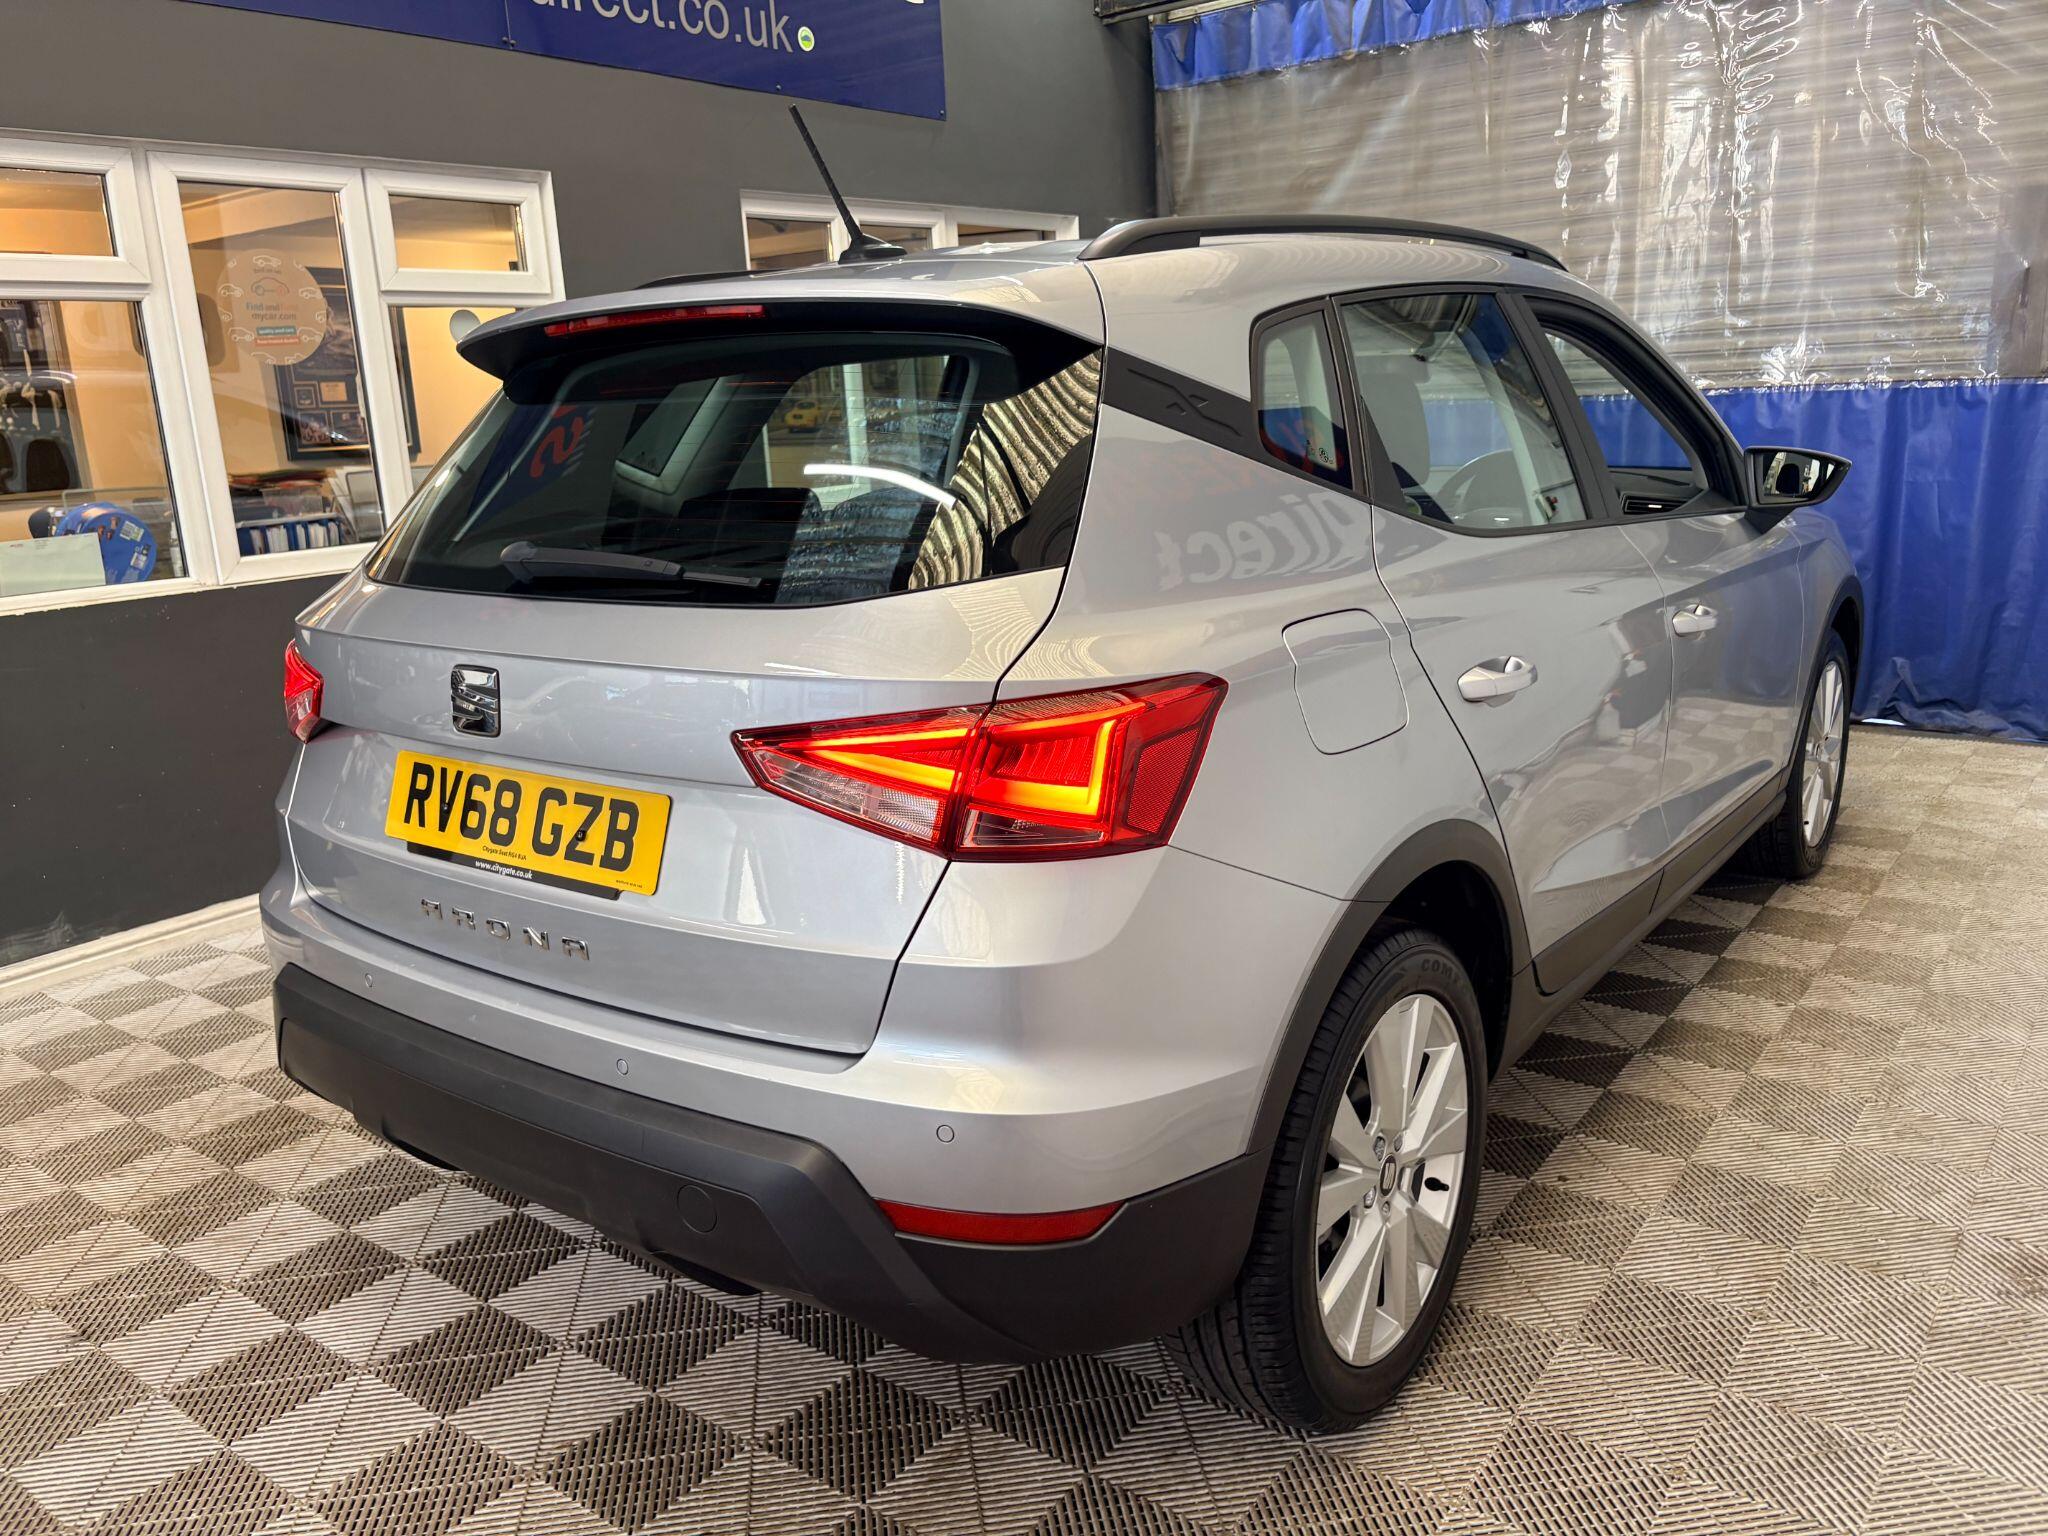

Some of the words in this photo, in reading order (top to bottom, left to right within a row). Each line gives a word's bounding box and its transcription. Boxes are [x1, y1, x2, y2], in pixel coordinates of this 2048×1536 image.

[531, 0, 793, 52] ct.co.uk
[403, 762, 522, 847] RV68
[531, 787, 640, 872] GZB
[475, 860, 533, 879] www.citygate.co.uk
[421, 899, 590, 961] ARONA
